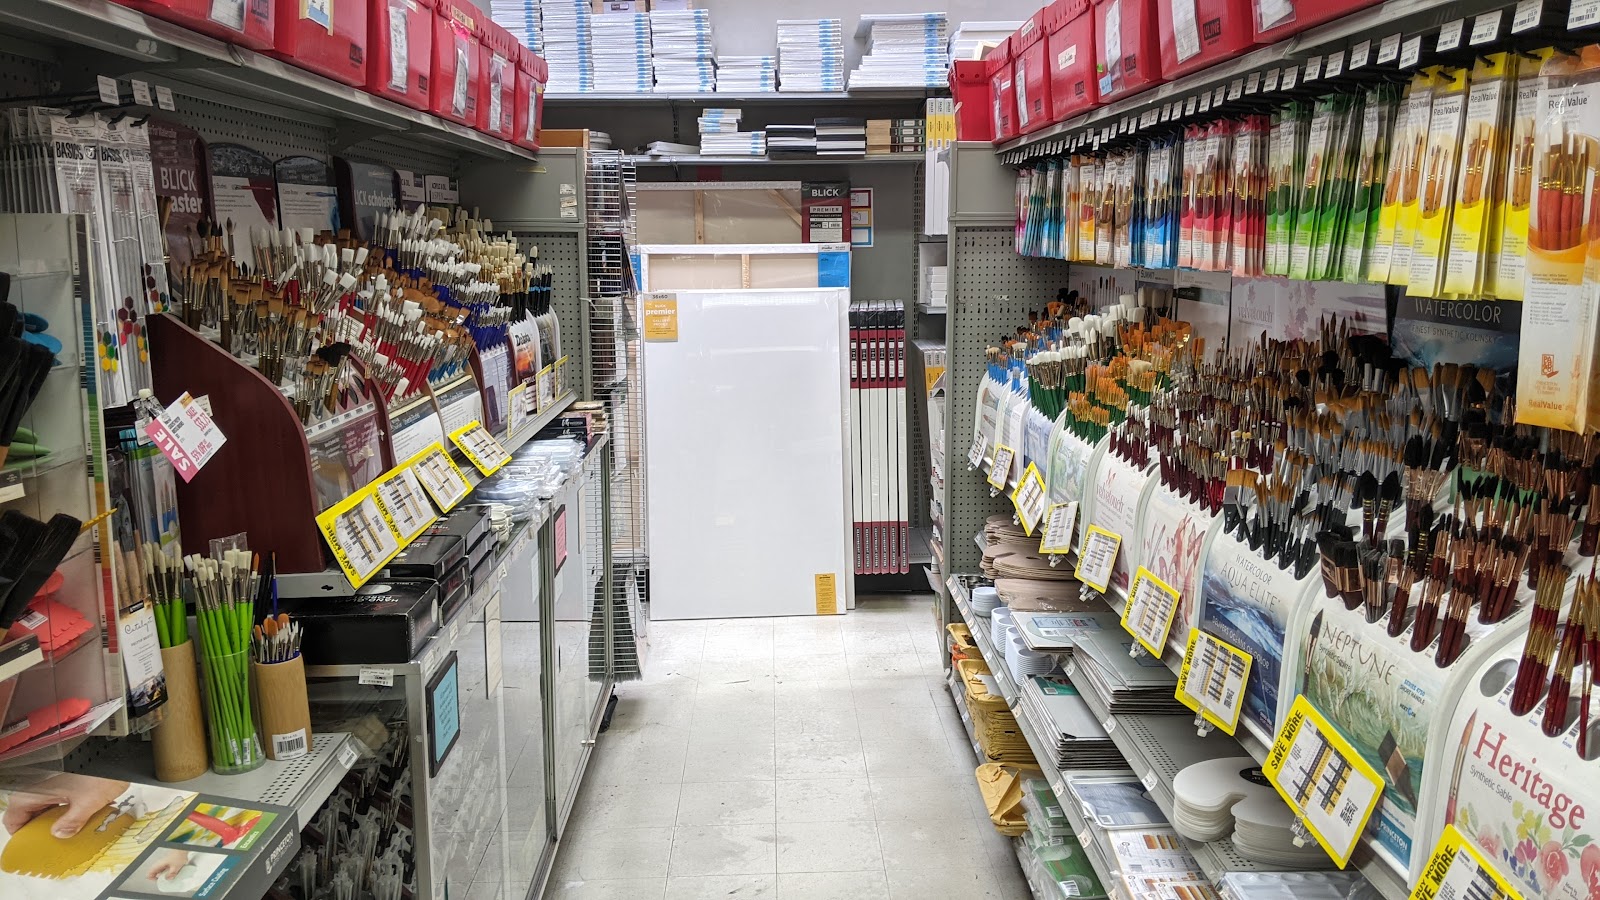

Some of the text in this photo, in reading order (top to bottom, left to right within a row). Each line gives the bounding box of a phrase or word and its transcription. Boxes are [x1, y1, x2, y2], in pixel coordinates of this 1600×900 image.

[1204, 20, 1221, 38] ULINE
[1471, 92, 1498, 104] RealValue
[1519, 88, 1538, 100] RealVa
[1434, 106, 1460, 116] RealValue
[56, 141, 84, 160] BASICS
[160, 166, 197, 192] BLICK
[811, 189, 840, 197] BLICK
[170, 192, 203, 214] aster
[646, 308, 676, 316] premier
[1415, 298, 1502, 324] WATERCOLOR
[1412, 324, 1495, 344] FINEST SYNTHETIC KOLINSKY
[1529, 399, 1562, 411] RealValue
[153, 428, 191, 472] SALE
[373, 492, 402, 538] SAVE MORE
[324, 523, 357, 576] SAVE MORE
[1236, 554, 1272, 586] WATERCOLOR
[1220, 562, 1278, 613] AQUA ELITE
[1181, 668, 1190, 691] SAVE
[1187, 639, 1197, 666] MORE
[1319, 643, 1338, 661] Synthetic
[1323, 621, 1396, 685] NEPTUNE
[1270, 709, 1303, 770] SAVE MORE
[1272, 716, 1292, 754] BUY MORE
[1470, 765, 1512, 803] Synthetic Sable
[1473, 722, 1585, 830] Heritage
[270, 829, 294, 862] PRINCETON
[1380, 819, 1408, 850] PRINCETON
[1415, 852, 1441, 898] BUY MORE
[1418, 844, 1456, 900] VE MORE
